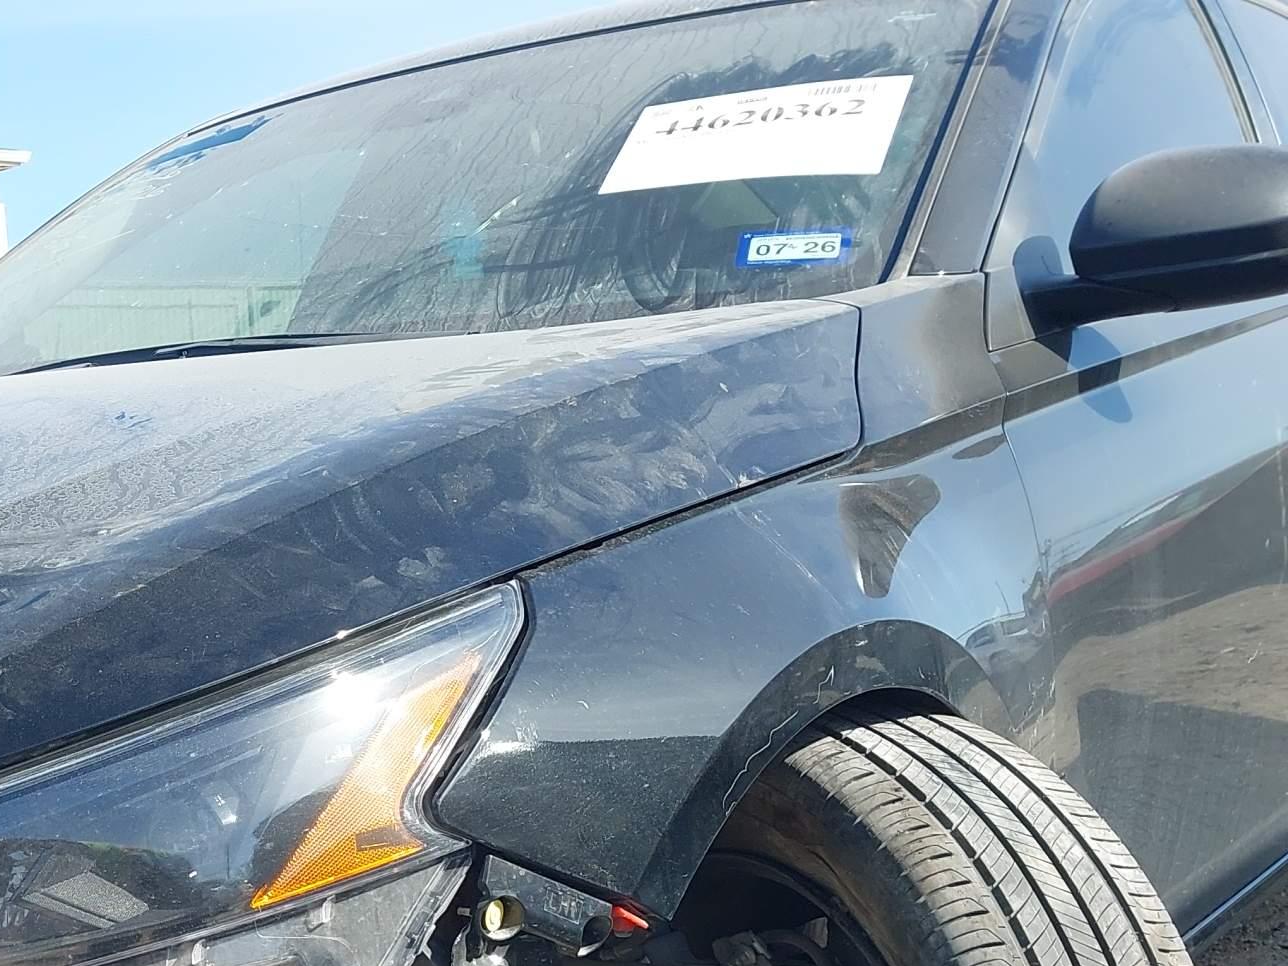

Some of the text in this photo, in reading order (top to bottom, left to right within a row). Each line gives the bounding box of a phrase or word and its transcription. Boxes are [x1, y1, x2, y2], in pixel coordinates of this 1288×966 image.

[655, 99, 866, 135] 44620362
[755, 240, 837, 256] 07 26
